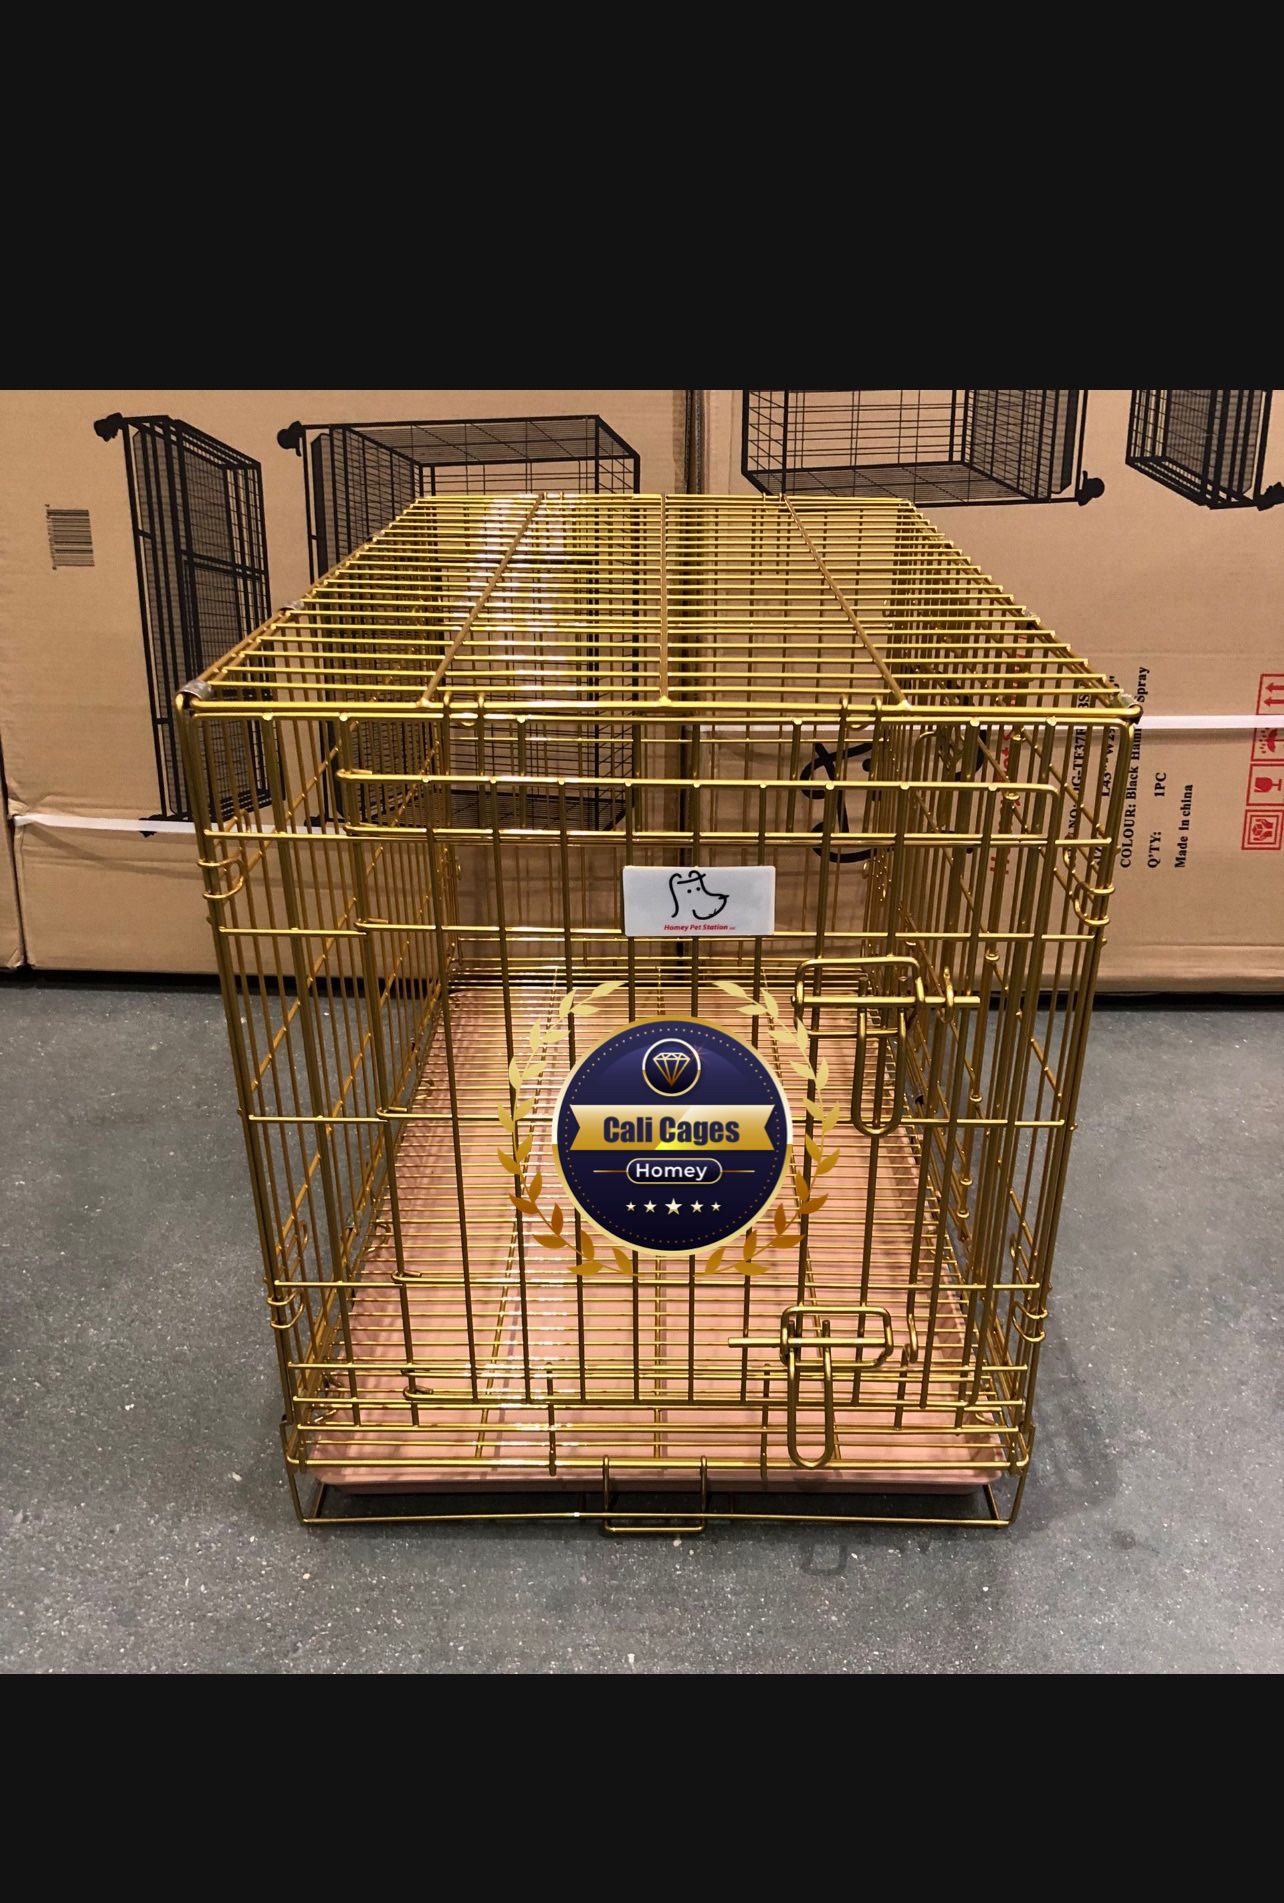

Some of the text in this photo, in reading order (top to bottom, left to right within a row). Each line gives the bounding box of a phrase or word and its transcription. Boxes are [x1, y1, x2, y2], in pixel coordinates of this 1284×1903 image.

[1136, 667, 1150, 702] Spray
[1126, 766, 1139, 800] Black
[1154, 772, 1167, 797] 1PC
[1180, 784, 1193, 817] china
[1120, 804, 1137, 868] COLOUR:
[1174, 836, 1188, 868] Made
[664, 924, 689, 932] Homey
[703, 923, 728, 931] Station
